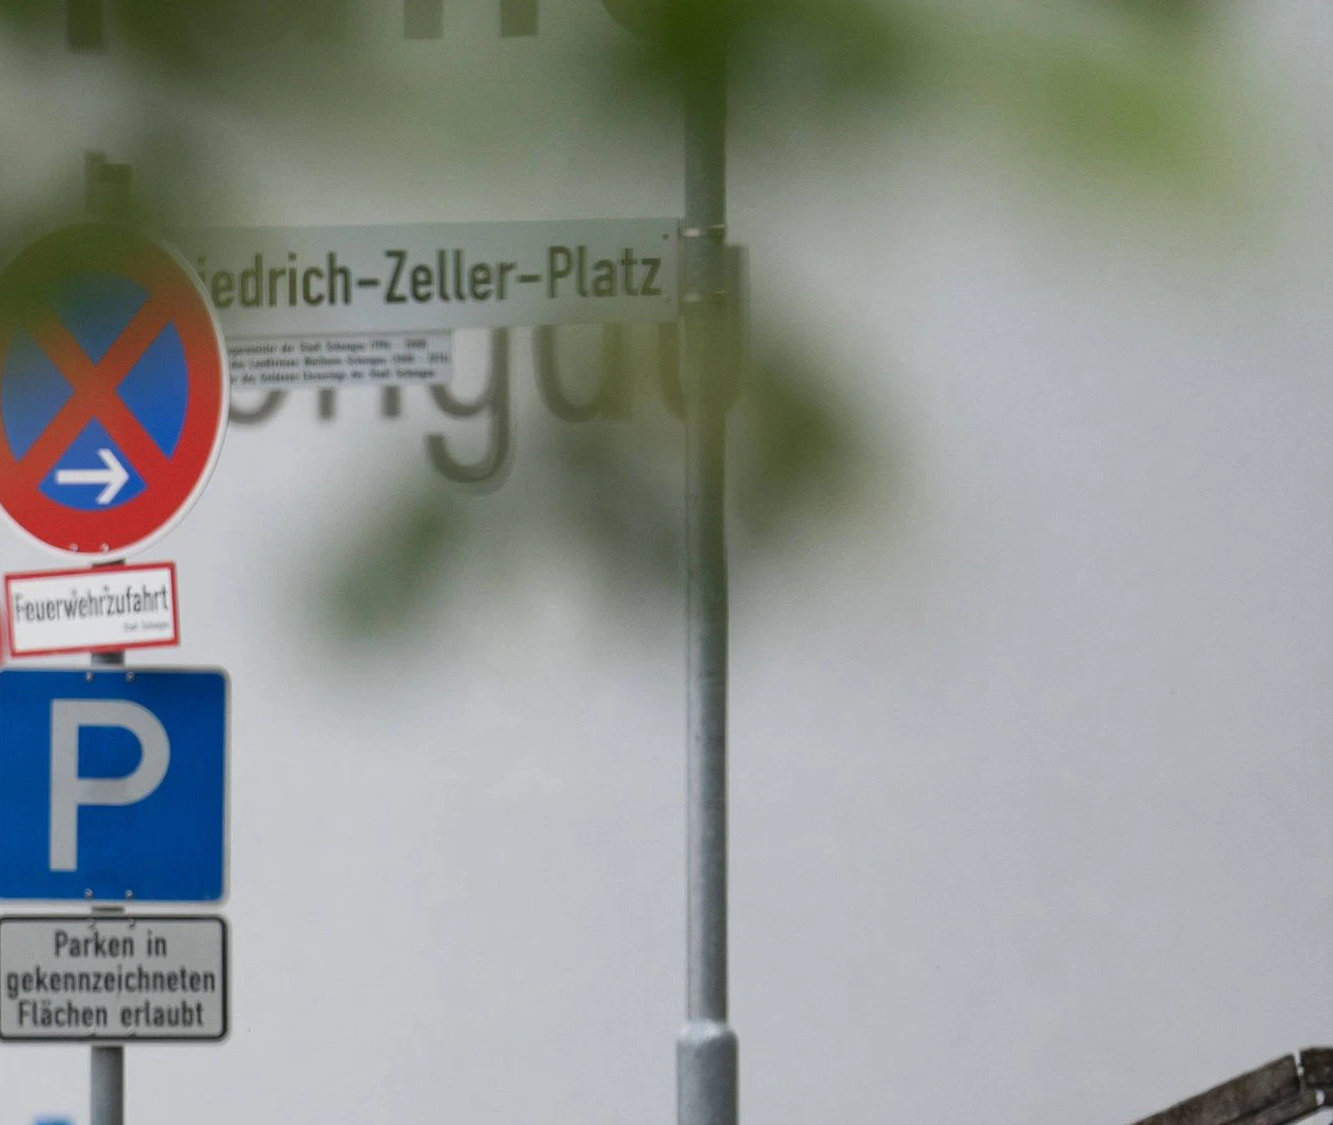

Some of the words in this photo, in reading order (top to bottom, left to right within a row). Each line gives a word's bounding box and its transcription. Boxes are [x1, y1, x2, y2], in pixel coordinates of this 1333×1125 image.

[15, 585, 169, 623] Feuerwehrzufahrt
[49, 699, 171, 871] P
[54, 929, 134, 957] Parken
[147, 929, 168, 957] in
[6, 964, 215, 999] gekennzeichneten
[18, 999, 108, 1027] Flächen
[121, 1000, 204, 1027] erlaubt
